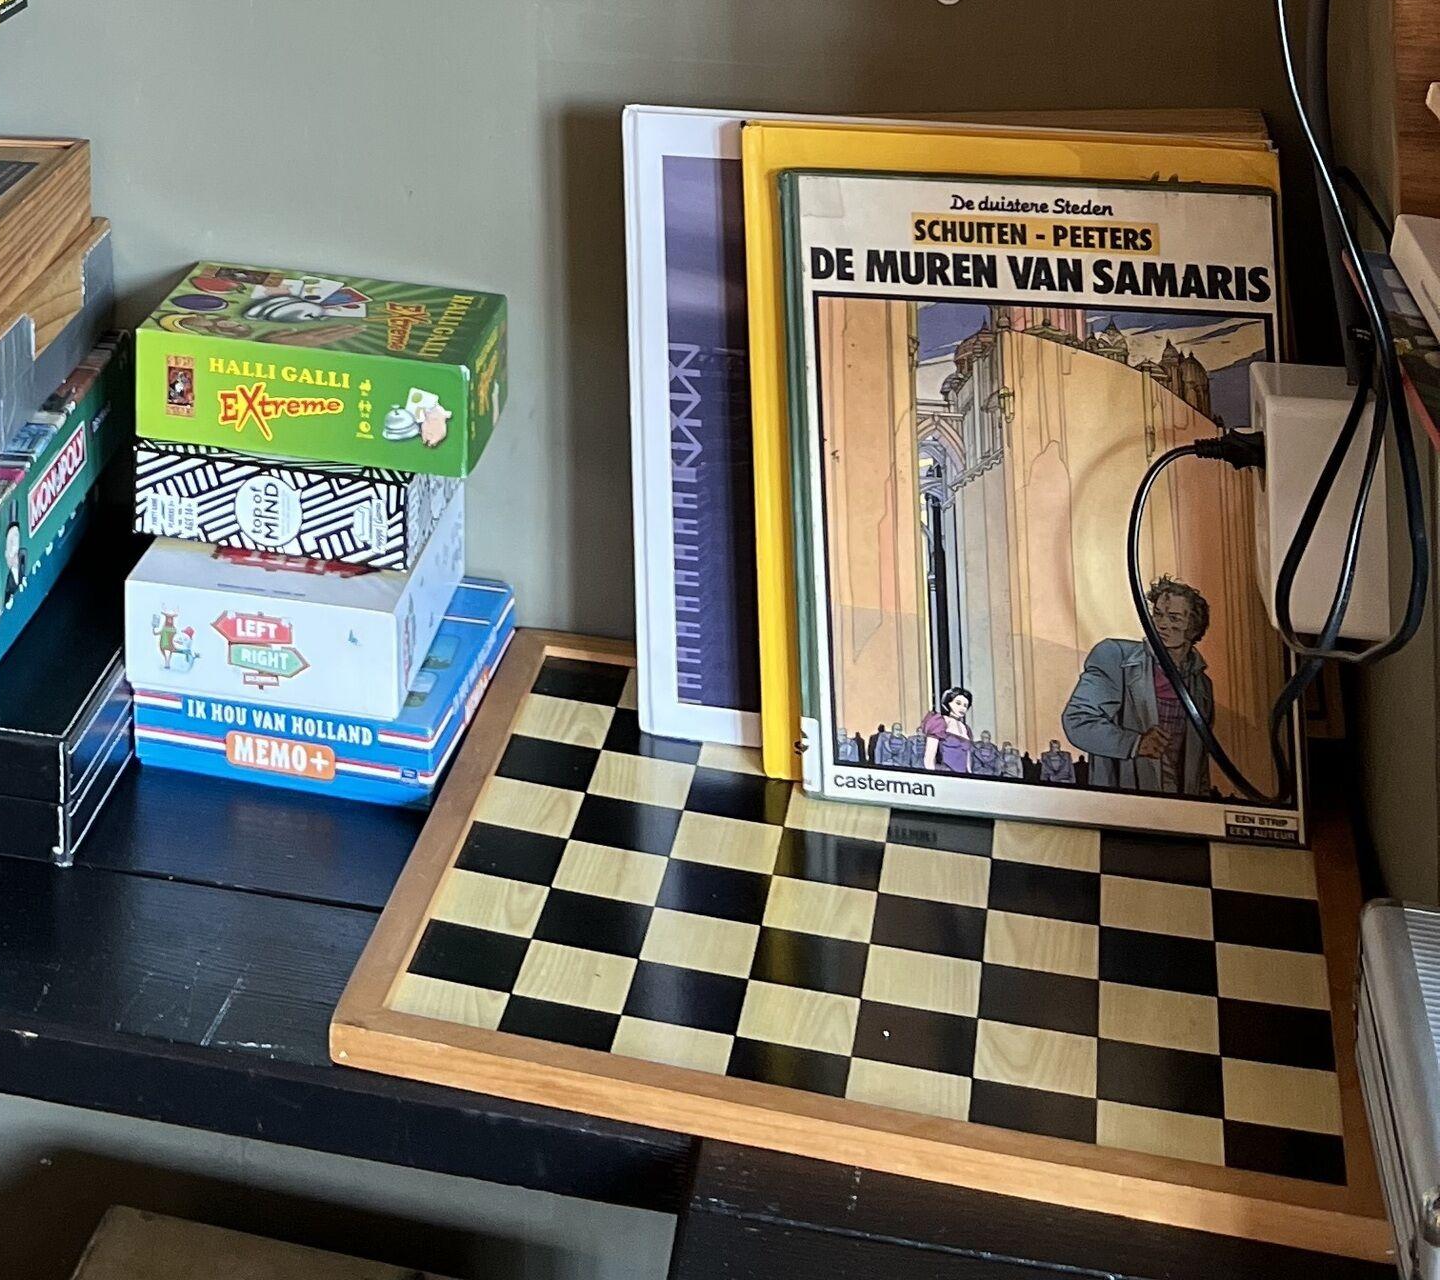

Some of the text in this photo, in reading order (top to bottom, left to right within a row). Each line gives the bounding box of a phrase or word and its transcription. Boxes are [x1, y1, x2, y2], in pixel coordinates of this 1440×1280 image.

[949, 194, 1114, 216] De duistere Steden
[913, 219, 1028, 246] SCHUITEN
[1052, 224, 1154, 252] PEETERS
[810, 245, 1272, 304] DE MUREN VAN SAMARIS
[417, 294, 475, 357] HALLI GALLI
[209, 357, 351, 389] HALLI GALLI
[30, 425, 87, 532] MONOPOLY
[251, 486, 263, 535] top of
[264, 482, 280, 540] MIND
[235, 618, 278, 641] LEFT
[240, 650, 290, 672] RIGHT
[186, 699, 373, 747] IK HOU VAN HOLLAND
[833, 773, 936, 798] casterman
[1234, 814, 1289, 827] EEN STRIP
